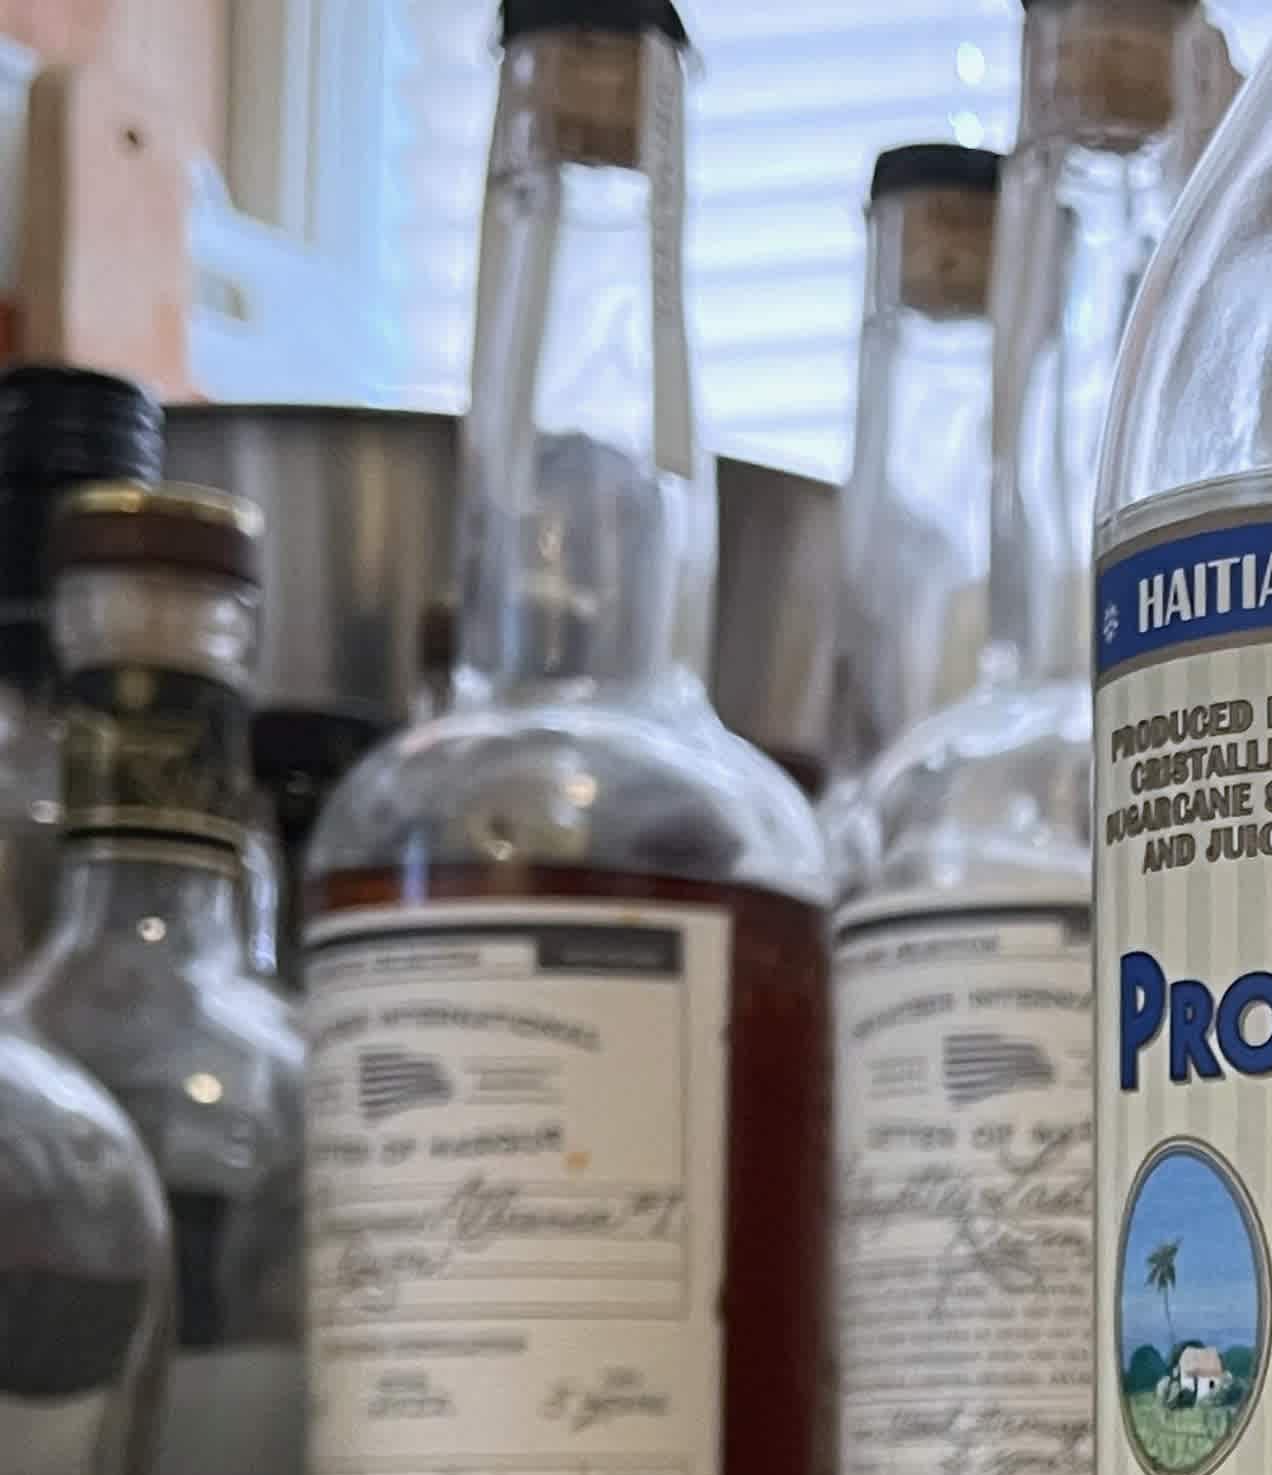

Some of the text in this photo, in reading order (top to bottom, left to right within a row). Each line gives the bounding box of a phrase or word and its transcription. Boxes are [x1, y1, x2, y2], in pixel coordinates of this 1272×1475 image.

[1110, 698, 1254, 764] PRODUCED
[1106, 781, 1254, 846] SUGARCANE
[1141, 833, 1197, 875] AND
